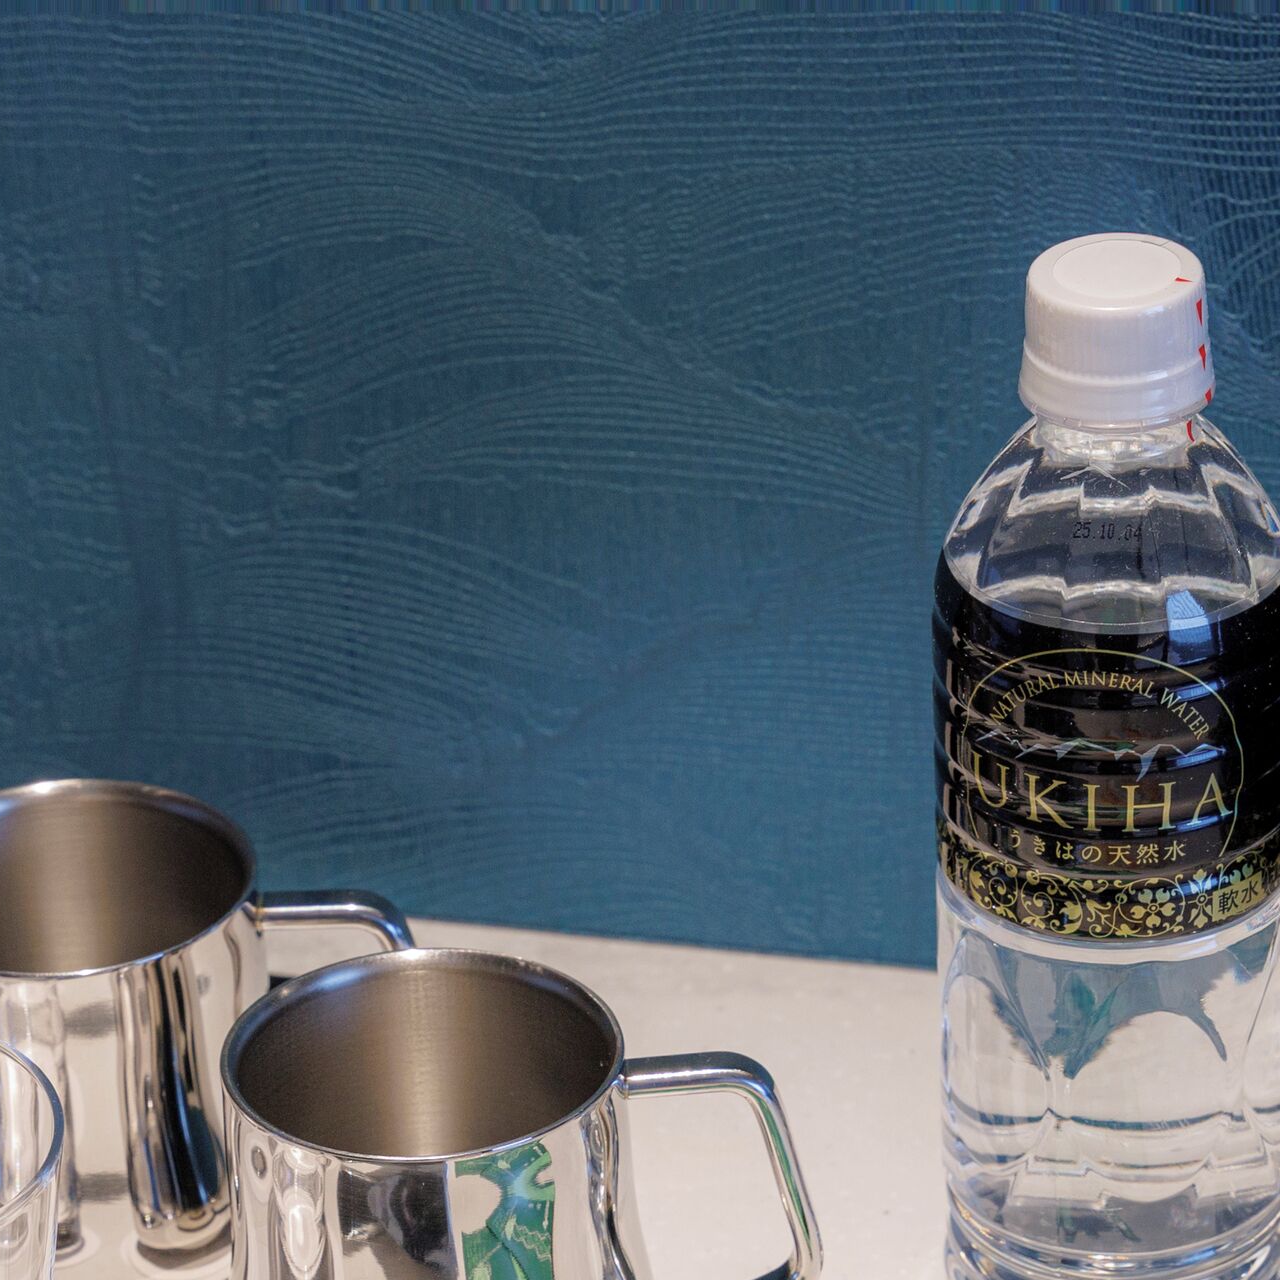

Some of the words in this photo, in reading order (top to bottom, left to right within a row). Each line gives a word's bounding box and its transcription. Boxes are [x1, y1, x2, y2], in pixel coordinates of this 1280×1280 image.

[1073, 521, 1142, 541] 25.10.04
[989, 674, 1060, 726] NATURAL
[1064, 670, 1154, 699] MINERAL
[1161, 687, 1210, 740] WATER
[972, 752, 1233, 832] UKIHA
[1011, 830, 1186, 865] うきはの天然水
